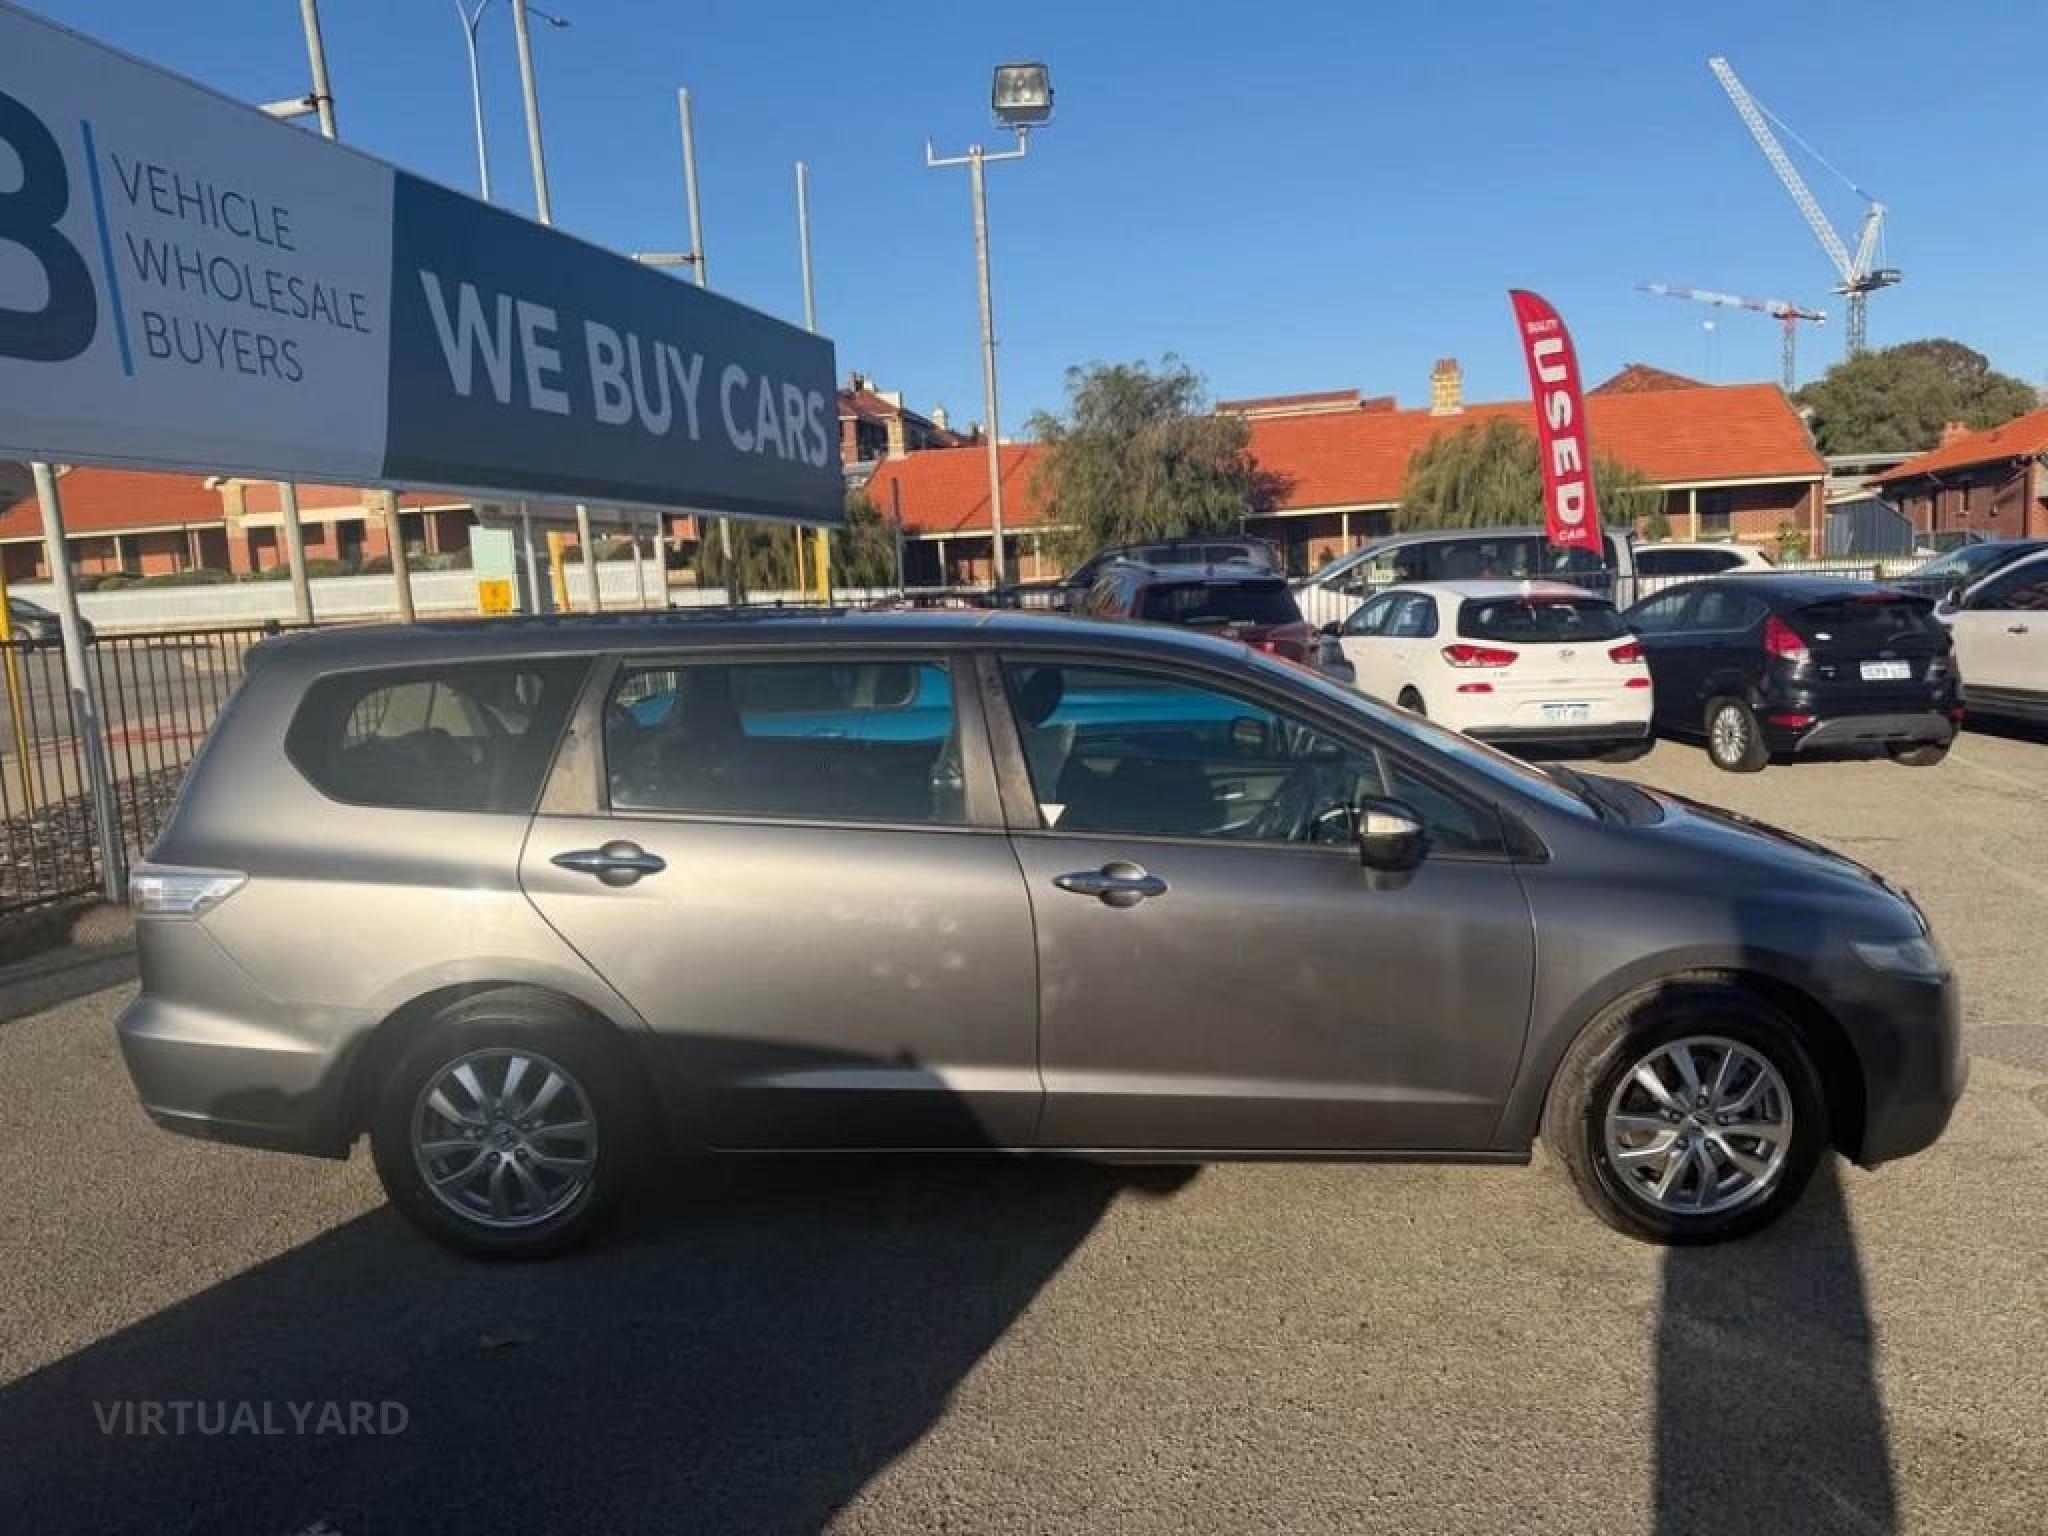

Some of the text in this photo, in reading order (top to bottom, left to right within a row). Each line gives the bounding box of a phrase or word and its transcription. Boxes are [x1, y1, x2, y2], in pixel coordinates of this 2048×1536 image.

[111, 152, 296, 251] VEHICLE
[126, 231, 371, 334] WHOLESALE
[143, 311, 303, 382] BUYERS
[418, 269, 828, 467] WE BUY CARS
[1533, 337, 1585, 525] USED
